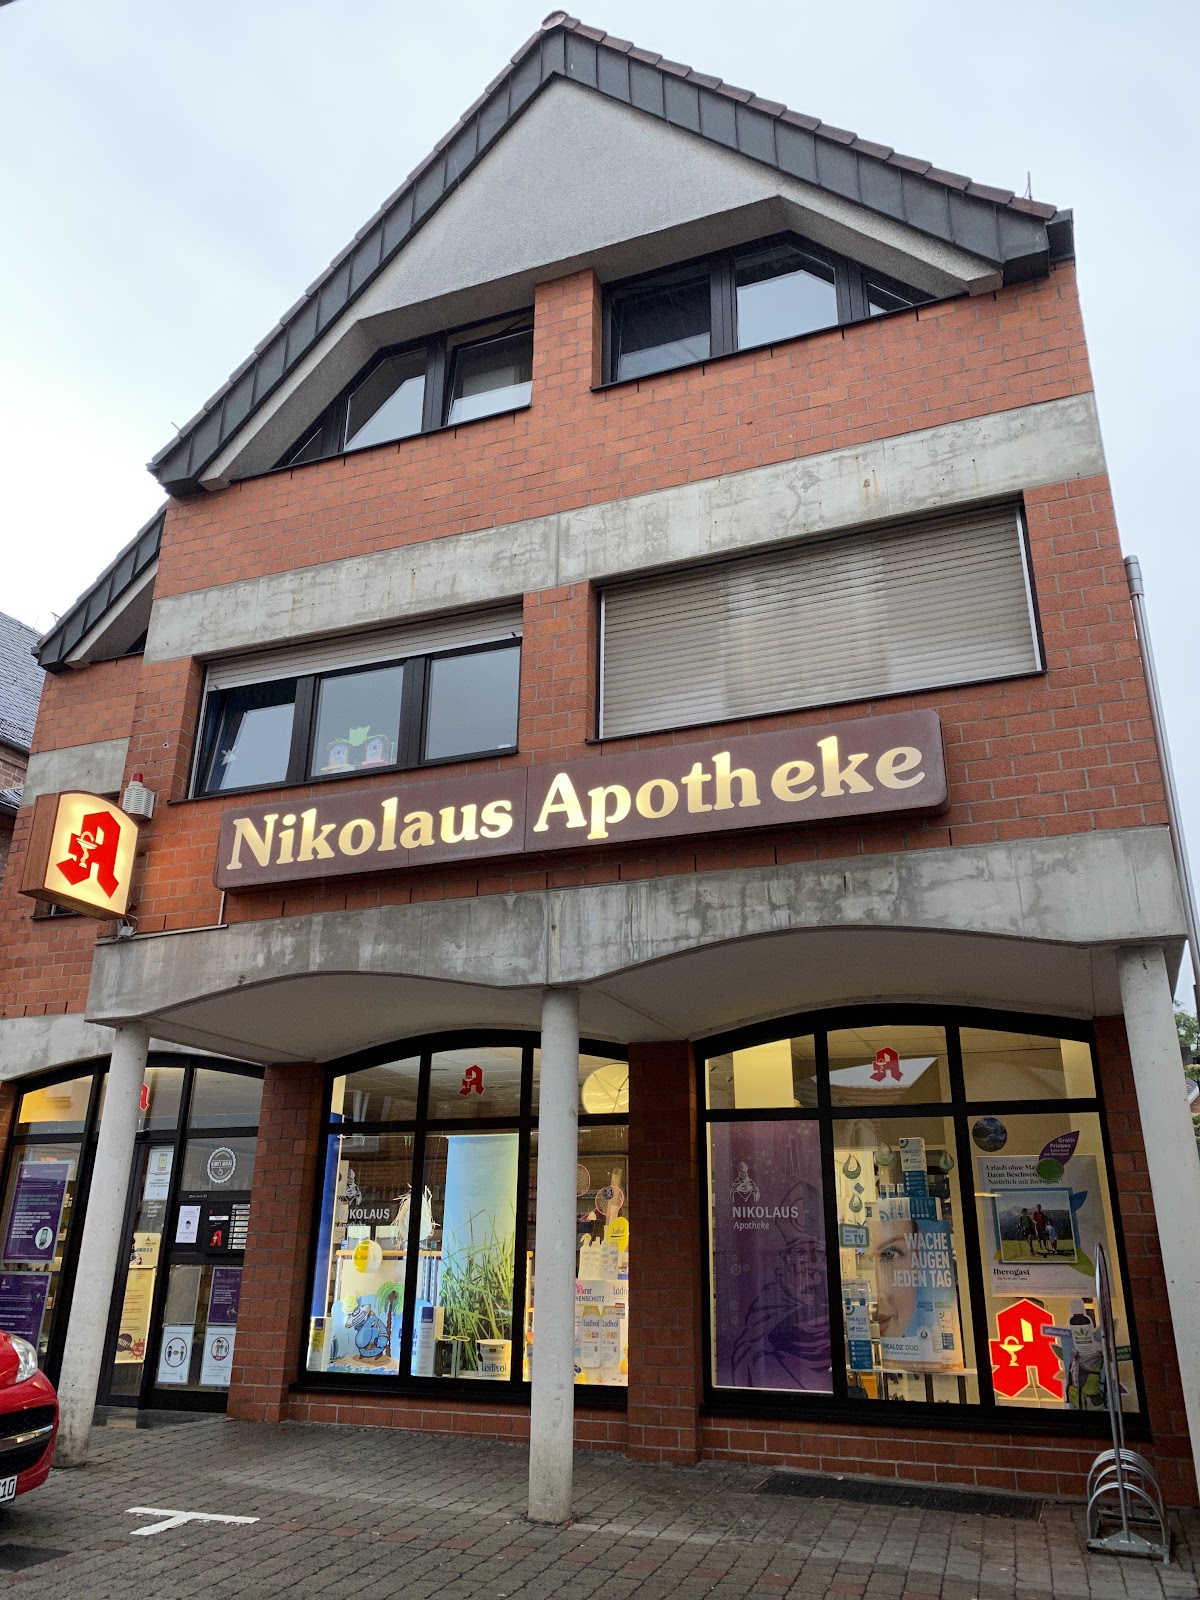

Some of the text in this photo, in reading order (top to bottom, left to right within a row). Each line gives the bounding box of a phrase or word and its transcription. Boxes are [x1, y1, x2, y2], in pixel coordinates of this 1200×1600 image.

[226, 736, 926, 870] Nikolaus Apotheke
[732, 1206, 799, 1219] NIKOLAUS
[733, 1221, 770, 1232] Apotheke
[853, 1234, 864, 1244] TV
[903, 1232, 948, 1250] WACHE
[911, 1251, 950, 1269] AUGEN
[891, 1269, 952, 1288] JEDEN TAG
